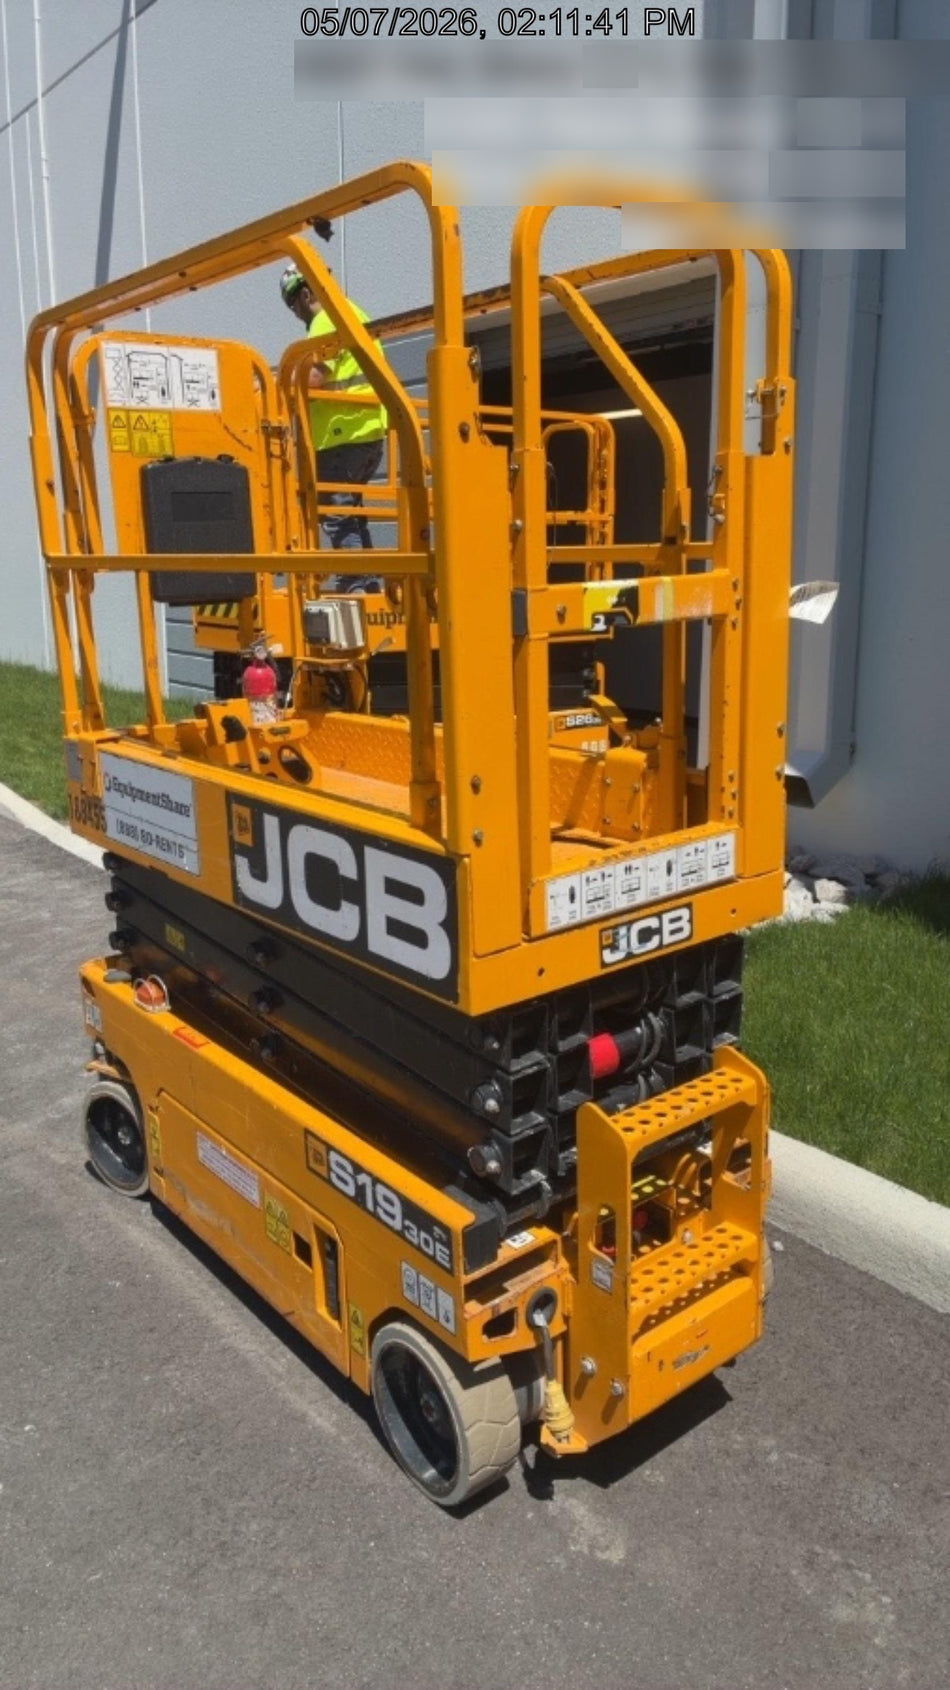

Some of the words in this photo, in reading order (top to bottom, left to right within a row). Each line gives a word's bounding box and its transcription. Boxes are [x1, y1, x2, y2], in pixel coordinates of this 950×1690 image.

[112, 776, 191, 818] EquipmentShare
[234, 812, 451, 980] JCB
[602, 906, 692, 965] JCB
